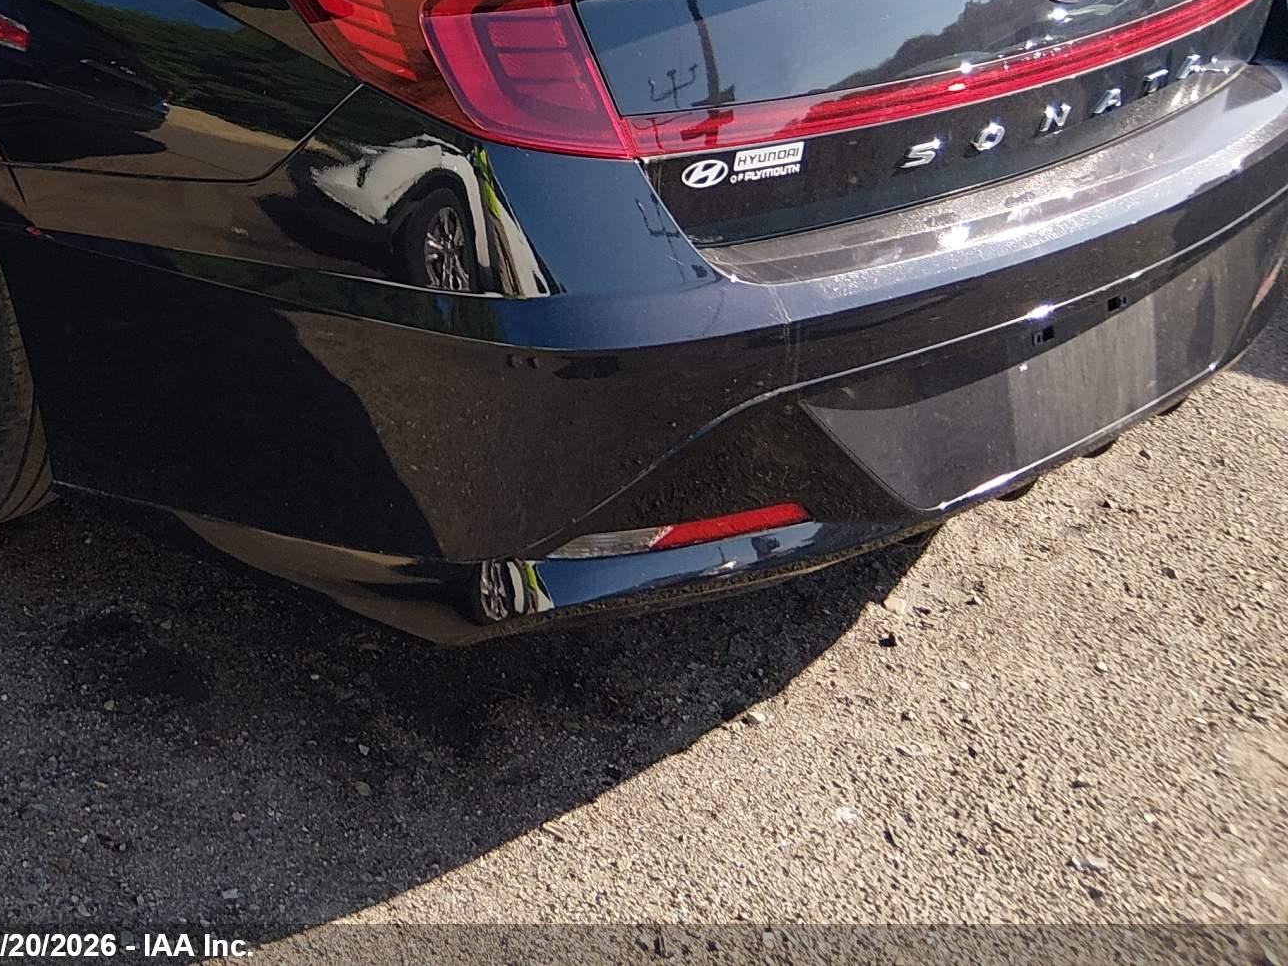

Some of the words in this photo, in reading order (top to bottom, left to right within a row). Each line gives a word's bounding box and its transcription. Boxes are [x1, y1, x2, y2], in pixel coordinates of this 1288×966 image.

[737, 147, 800, 167] HYUNDAI
[729, 173, 744, 184] OF
[744, 163, 801, 182] PLYMOUTH
